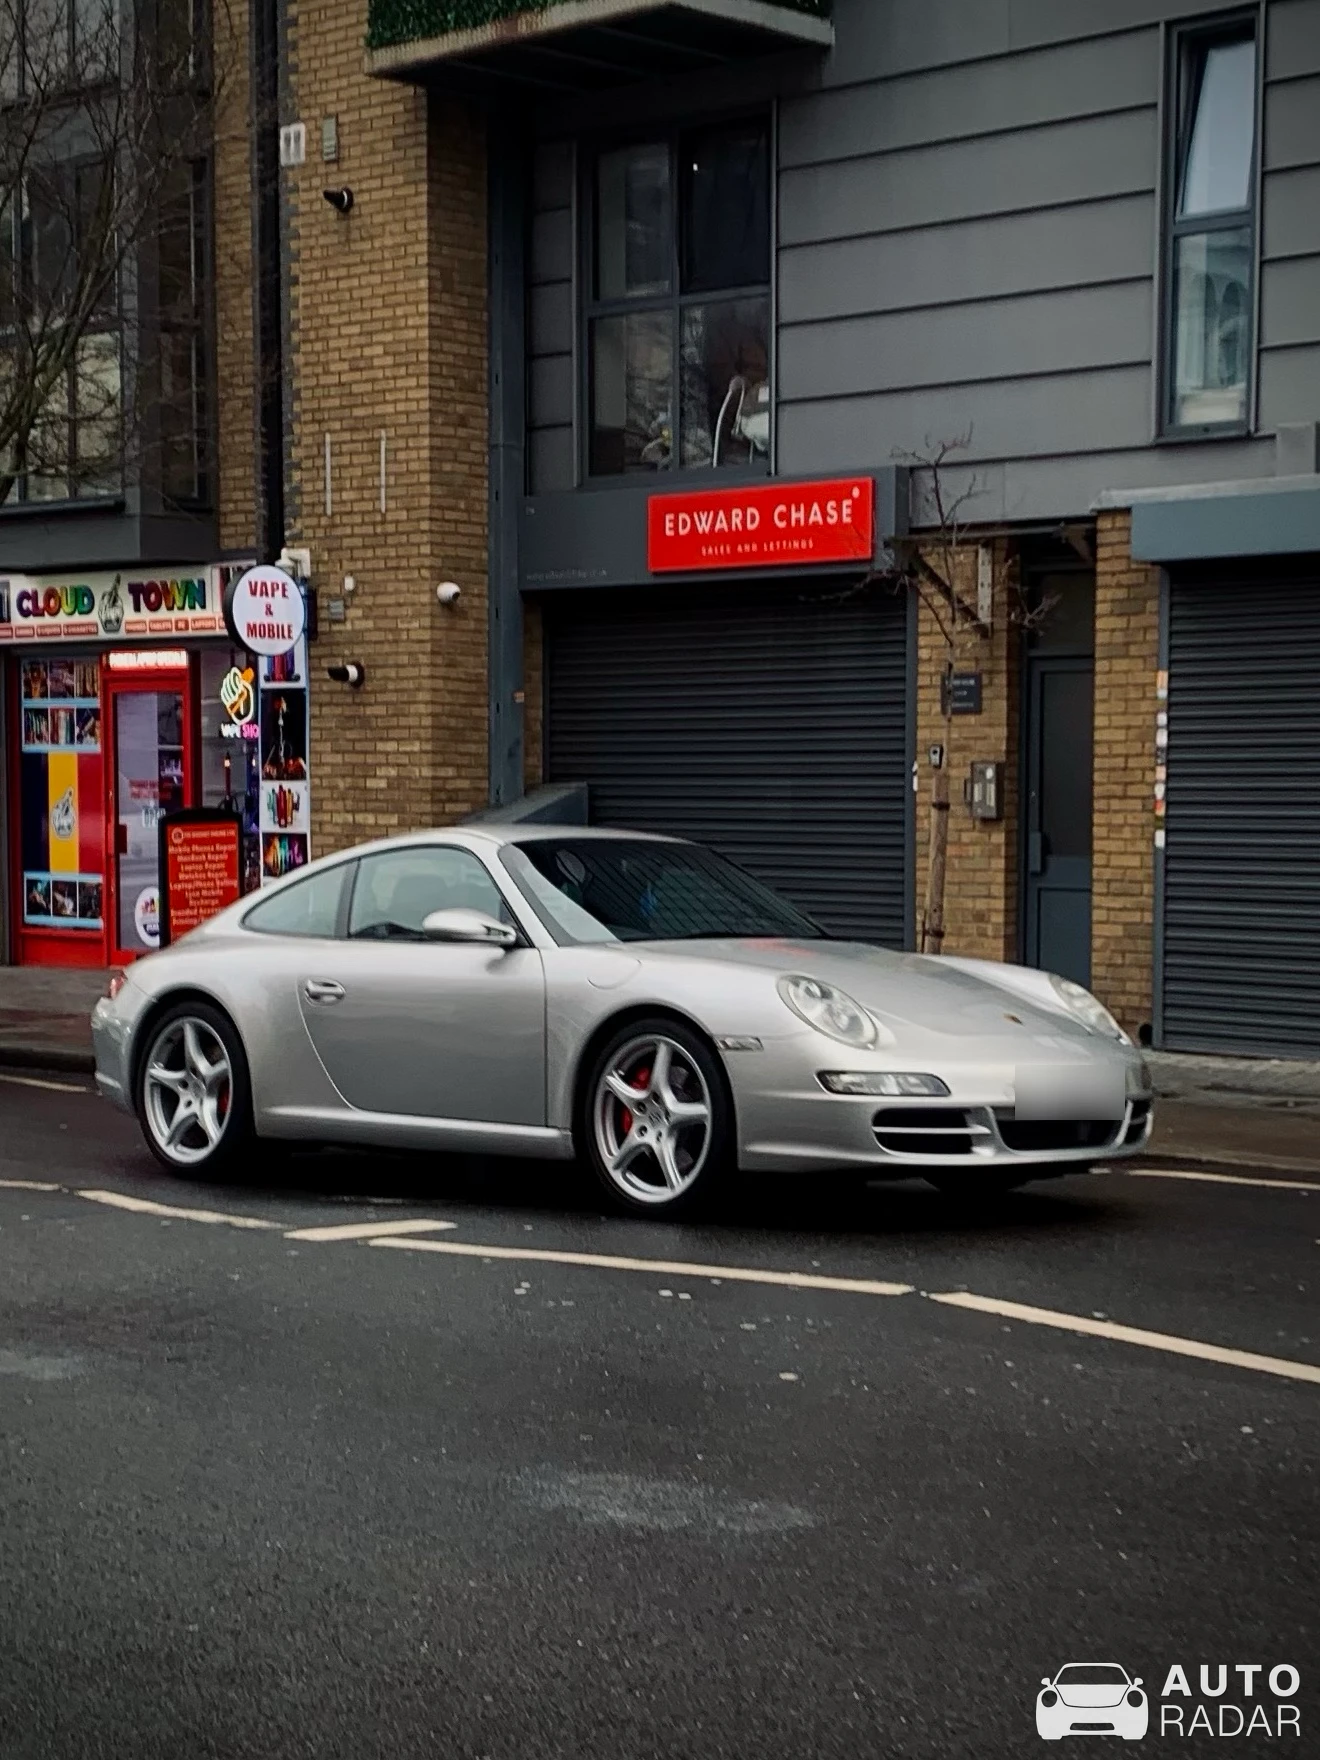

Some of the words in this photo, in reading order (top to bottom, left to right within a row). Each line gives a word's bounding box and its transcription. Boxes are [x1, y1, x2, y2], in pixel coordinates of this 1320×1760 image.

[664, 506, 760, 537] EDWARD
[773, 498, 853, 529] CHASE
[701, 543, 731, 557] SALES
[736, 541, 758, 554] AND
[763, 536, 814, 552] LETTINGS
[16, 583, 96, 618] CLOUD
[127, 577, 207, 613] TOWN
[247, 579, 290, 600] VAPE
[264, 603, 274, 617] &
[246, 622, 294, 641] MOBILE
